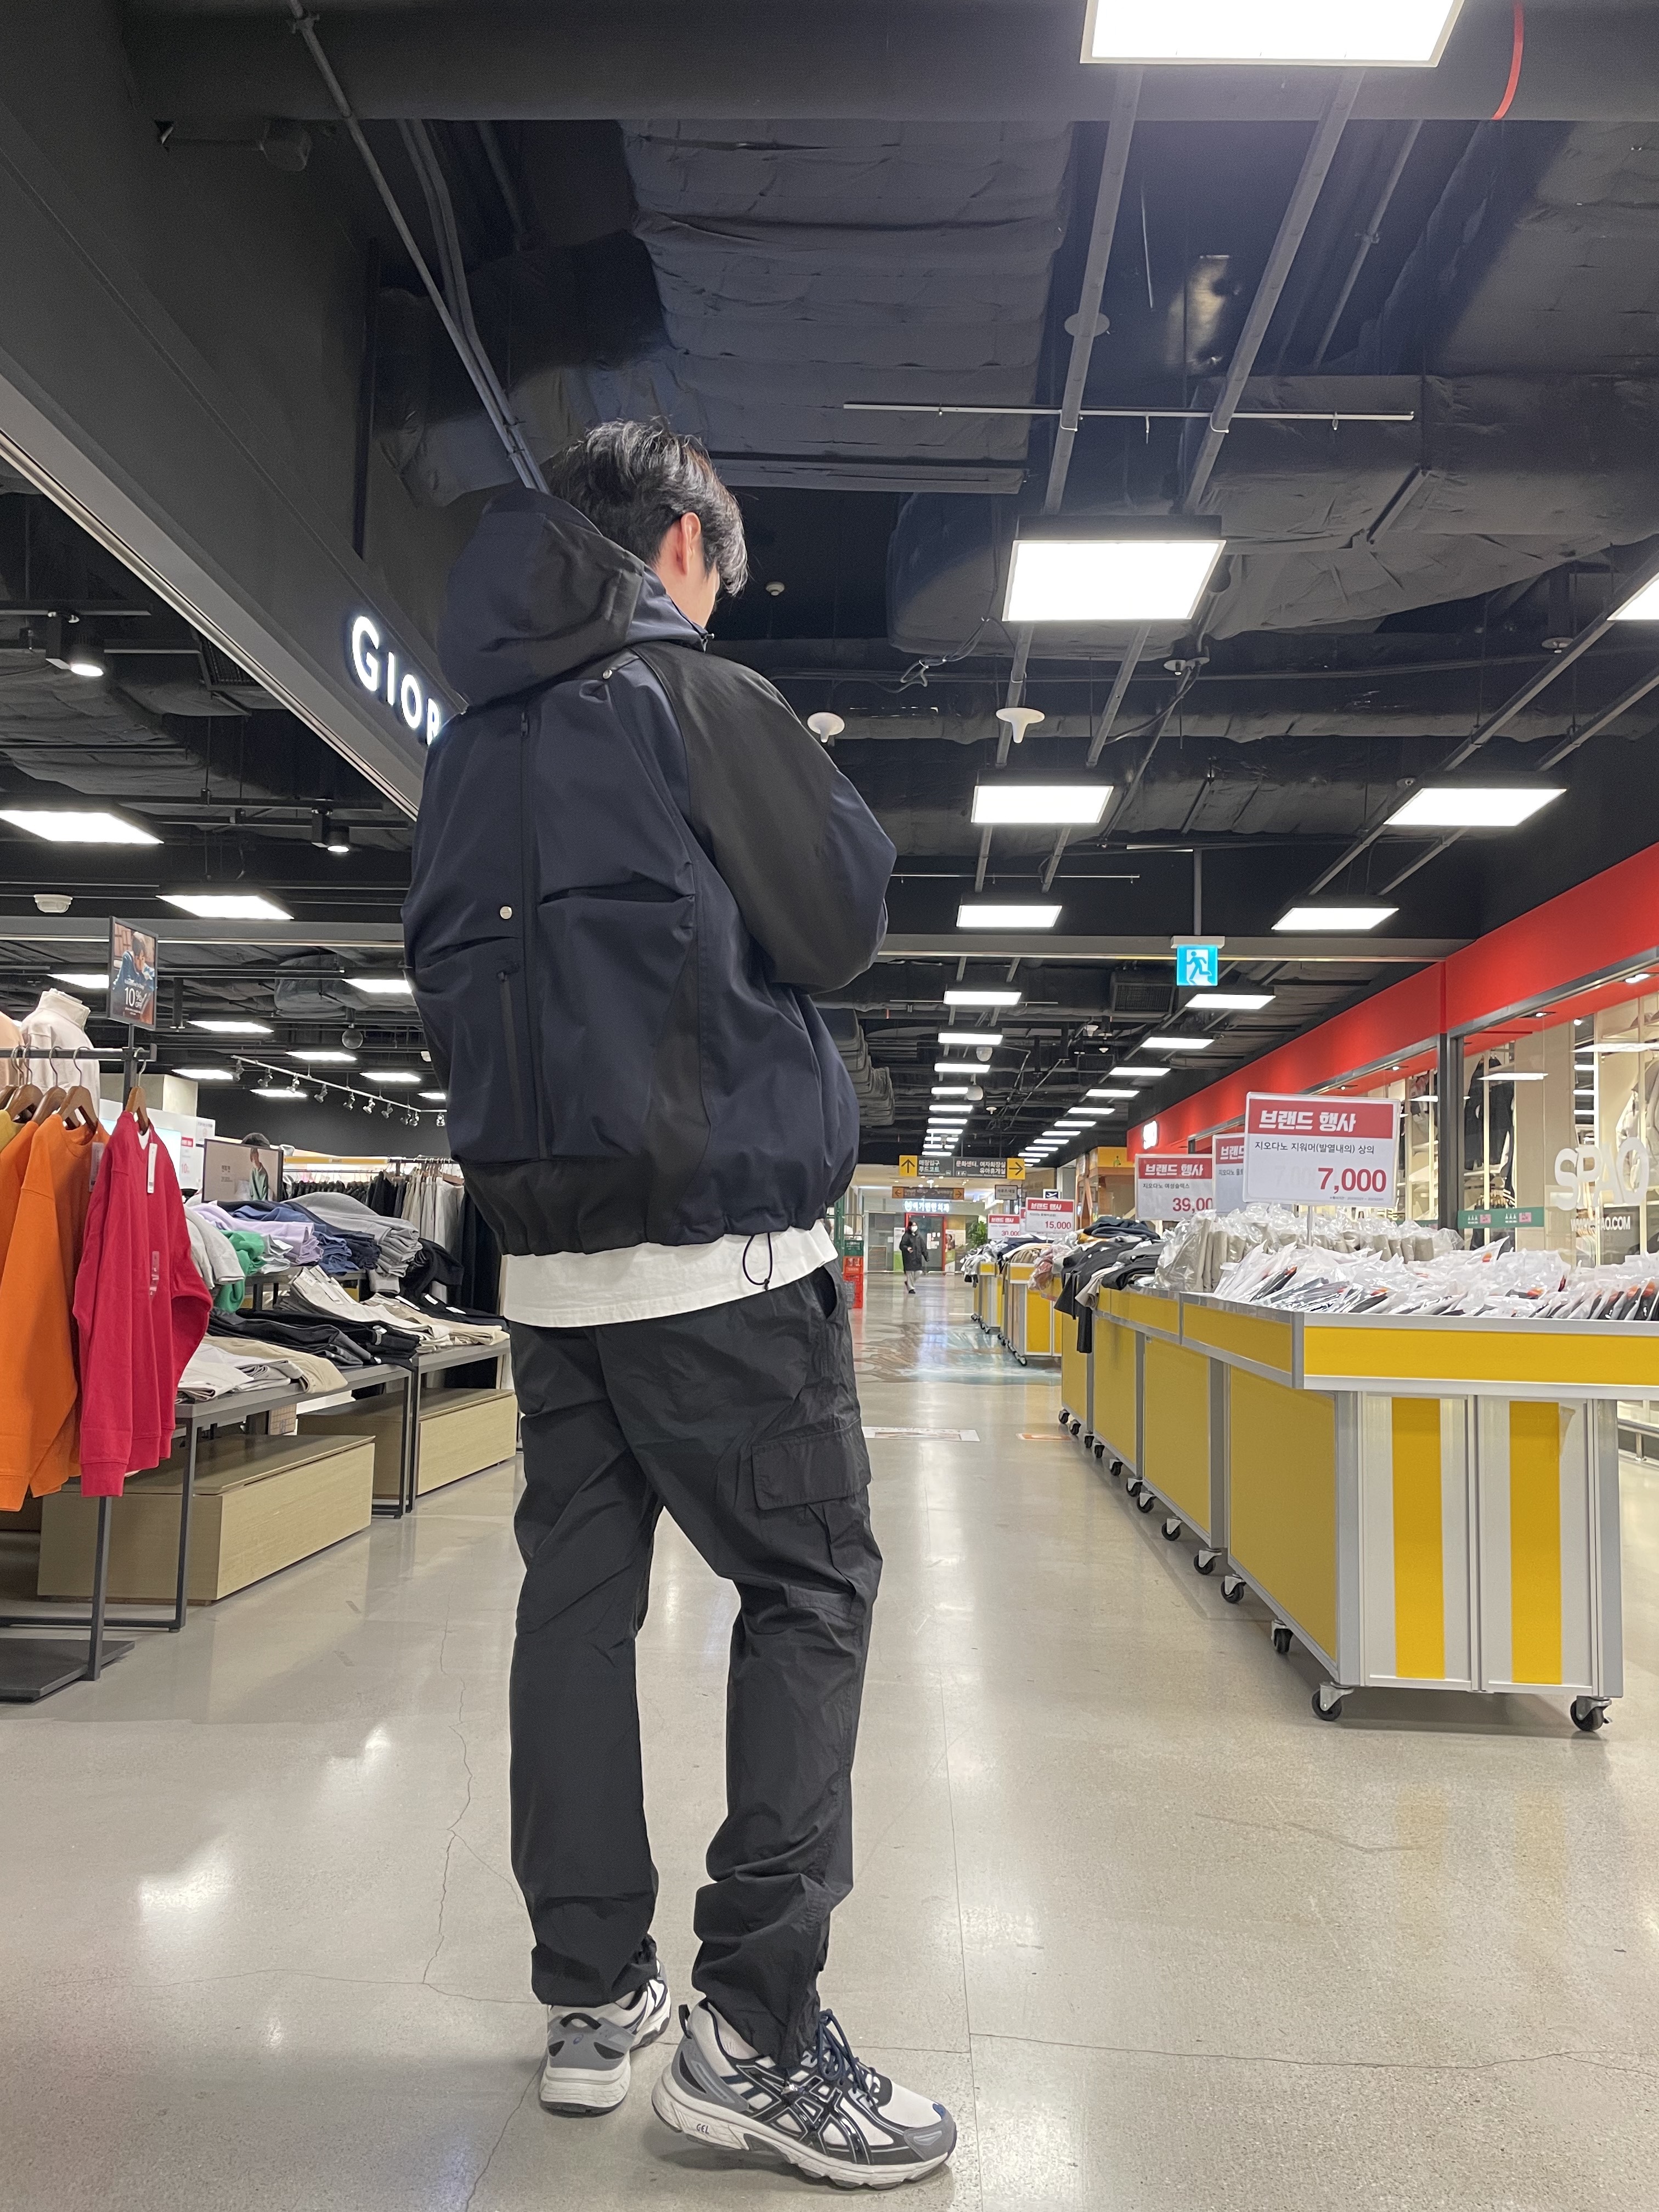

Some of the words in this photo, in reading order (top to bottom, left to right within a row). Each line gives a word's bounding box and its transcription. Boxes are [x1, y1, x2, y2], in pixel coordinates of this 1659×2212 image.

[1259, 1110, 1313, 1130] 브랜드
[1319, 1111, 1356, 1132] 행사
[1255, 1141, 1288, 1152] 지오다노
[1291, 1142, 1355, 1154] 지워머(발열내의)
[1358, 1144, 1374, 1154] 상의
[1144, 1164, 1178, 1176] 브랜드
[1181, 1164, 1204, 1176] 행사
[1554, 1137, 1650, 1211] SPAO
[1318, 1167, 1387, 1194] 7,000
[1045, 1221, 1071, 1229] 15,000
[696, 2123, 710, 2135] GEL
